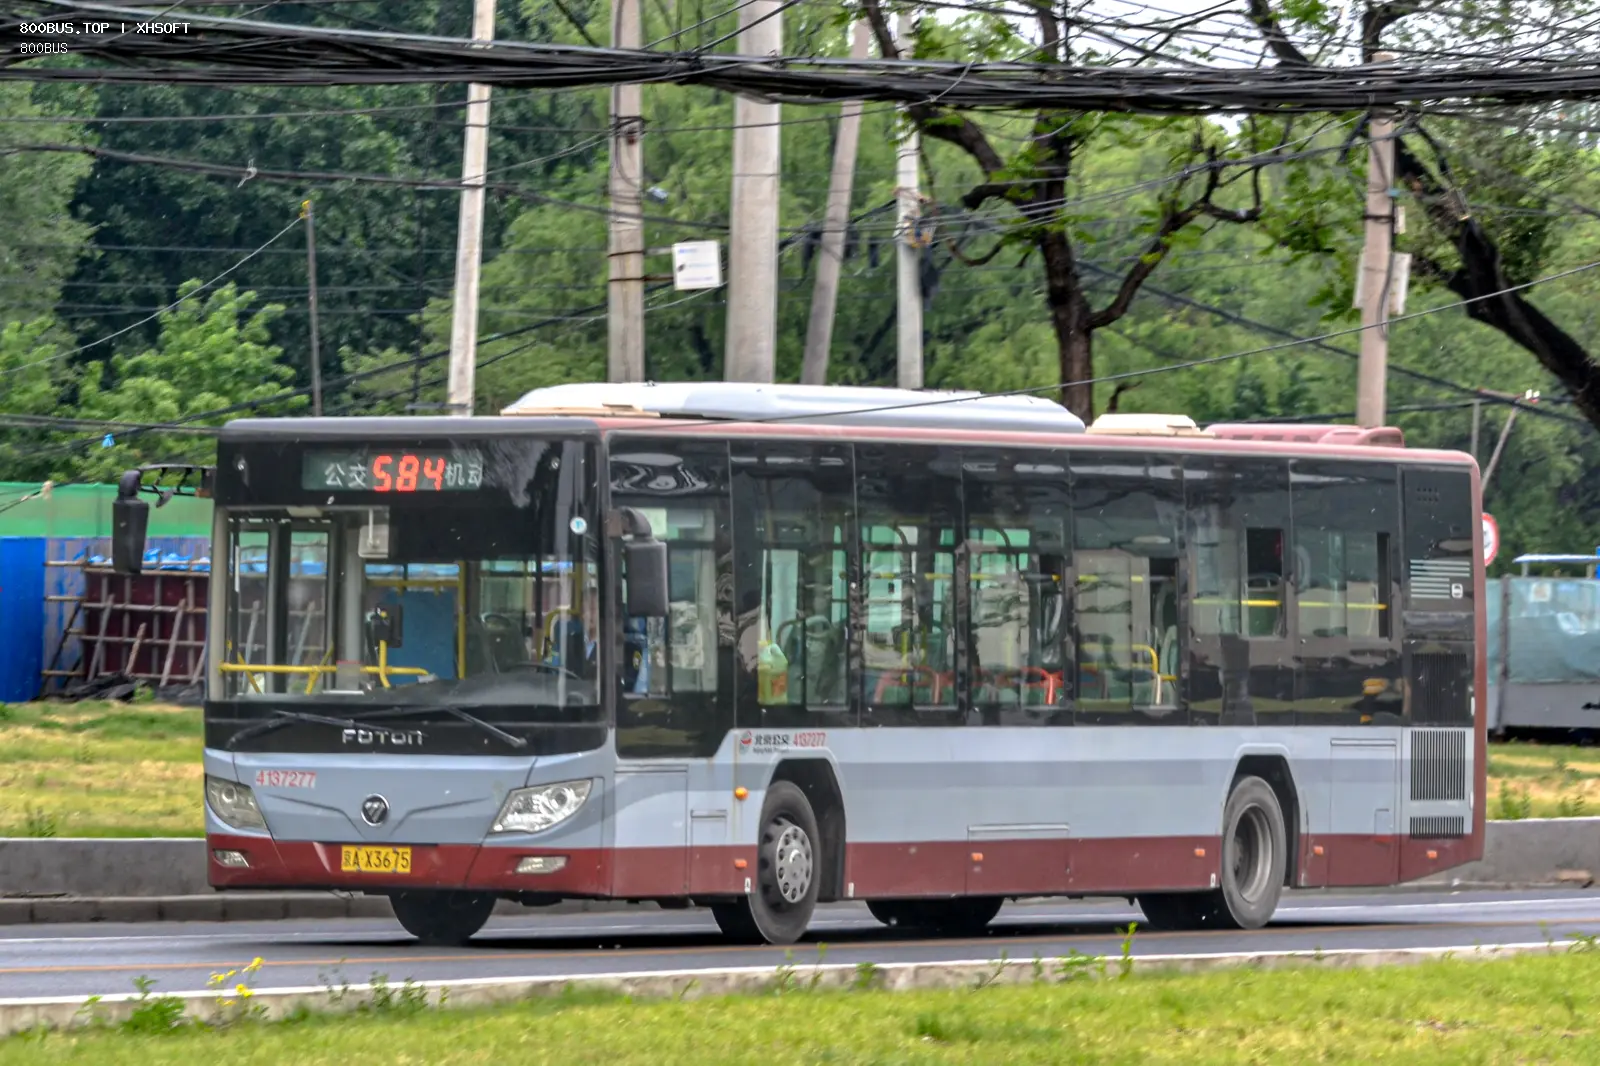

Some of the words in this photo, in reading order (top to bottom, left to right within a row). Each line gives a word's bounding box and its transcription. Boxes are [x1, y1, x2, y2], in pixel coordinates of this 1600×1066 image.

[324, 463, 367, 488] 公交
[371, 455, 446, 492] 584
[341, 728, 424, 745] FOTON
[793, 732, 826, 747] 4137277
[255, 770, 317, 788] 4137277
